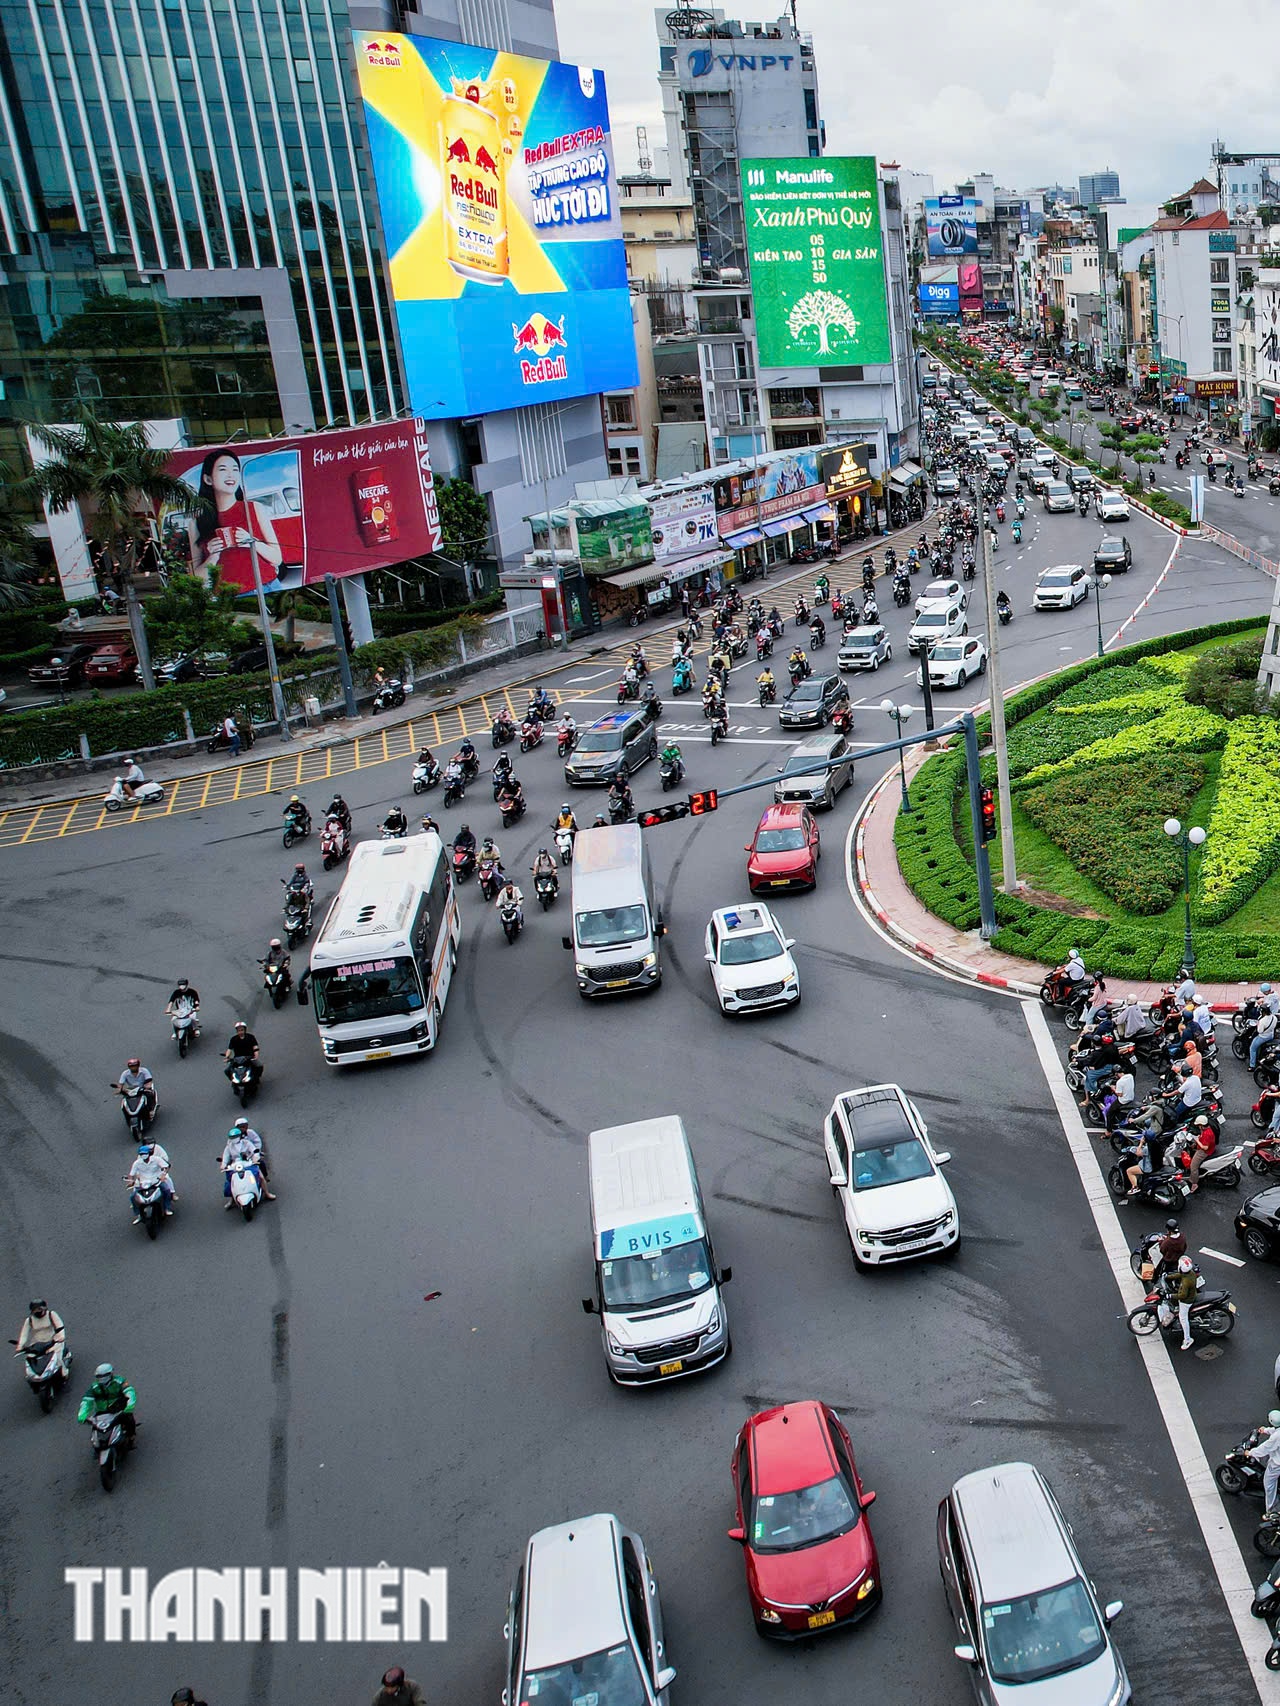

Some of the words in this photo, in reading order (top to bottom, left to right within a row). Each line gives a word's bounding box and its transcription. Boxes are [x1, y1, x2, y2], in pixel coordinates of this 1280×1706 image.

[369, 56, 384, 65] Red
[385, 57, 401, 66] Bull
[717, 55, 794, 71] VNPT
[524, 146, 541, 165] Red
[543, 138, 561, 159] Bull
[561, 126, 605, 152] EXTRA
[541, 163, 570, 187] TRUNG
[569, 158, 589, 179] CAO
[590, 149, 606, 178] ĐỘ
[775, 169, 834, 184] Manulife
[450, 174, 474, 200] Red
[475, 180, 498, 209] Bull
[532, 192, 562, 225] HÚC
[562, 186, 588, 220] TỚI
[588, 185, 608, 217] ĐI
[753, 206, 806, 228] Xanh
[806, 207, 839, 226] Phú
[840, 206, 873, 229] Quý
[458, 226, 494, 246] EXTRA
[809, 234, 824, 246] 05
[782, 250, 803, 263] TẠO
[810, 247, 825, 259] 10
[832, 249, 852, 261] GIA
[811, 260, 826, 271] 15
[812, 272, 828, 284] 50
[521, 359, 545, 383] Red
[544, 356, 567, 380] Bull
[698, 523, 714, 540] 7K
[692, 791, 716, 814] 21
[629, 1230, 672, 1252] BVIS
